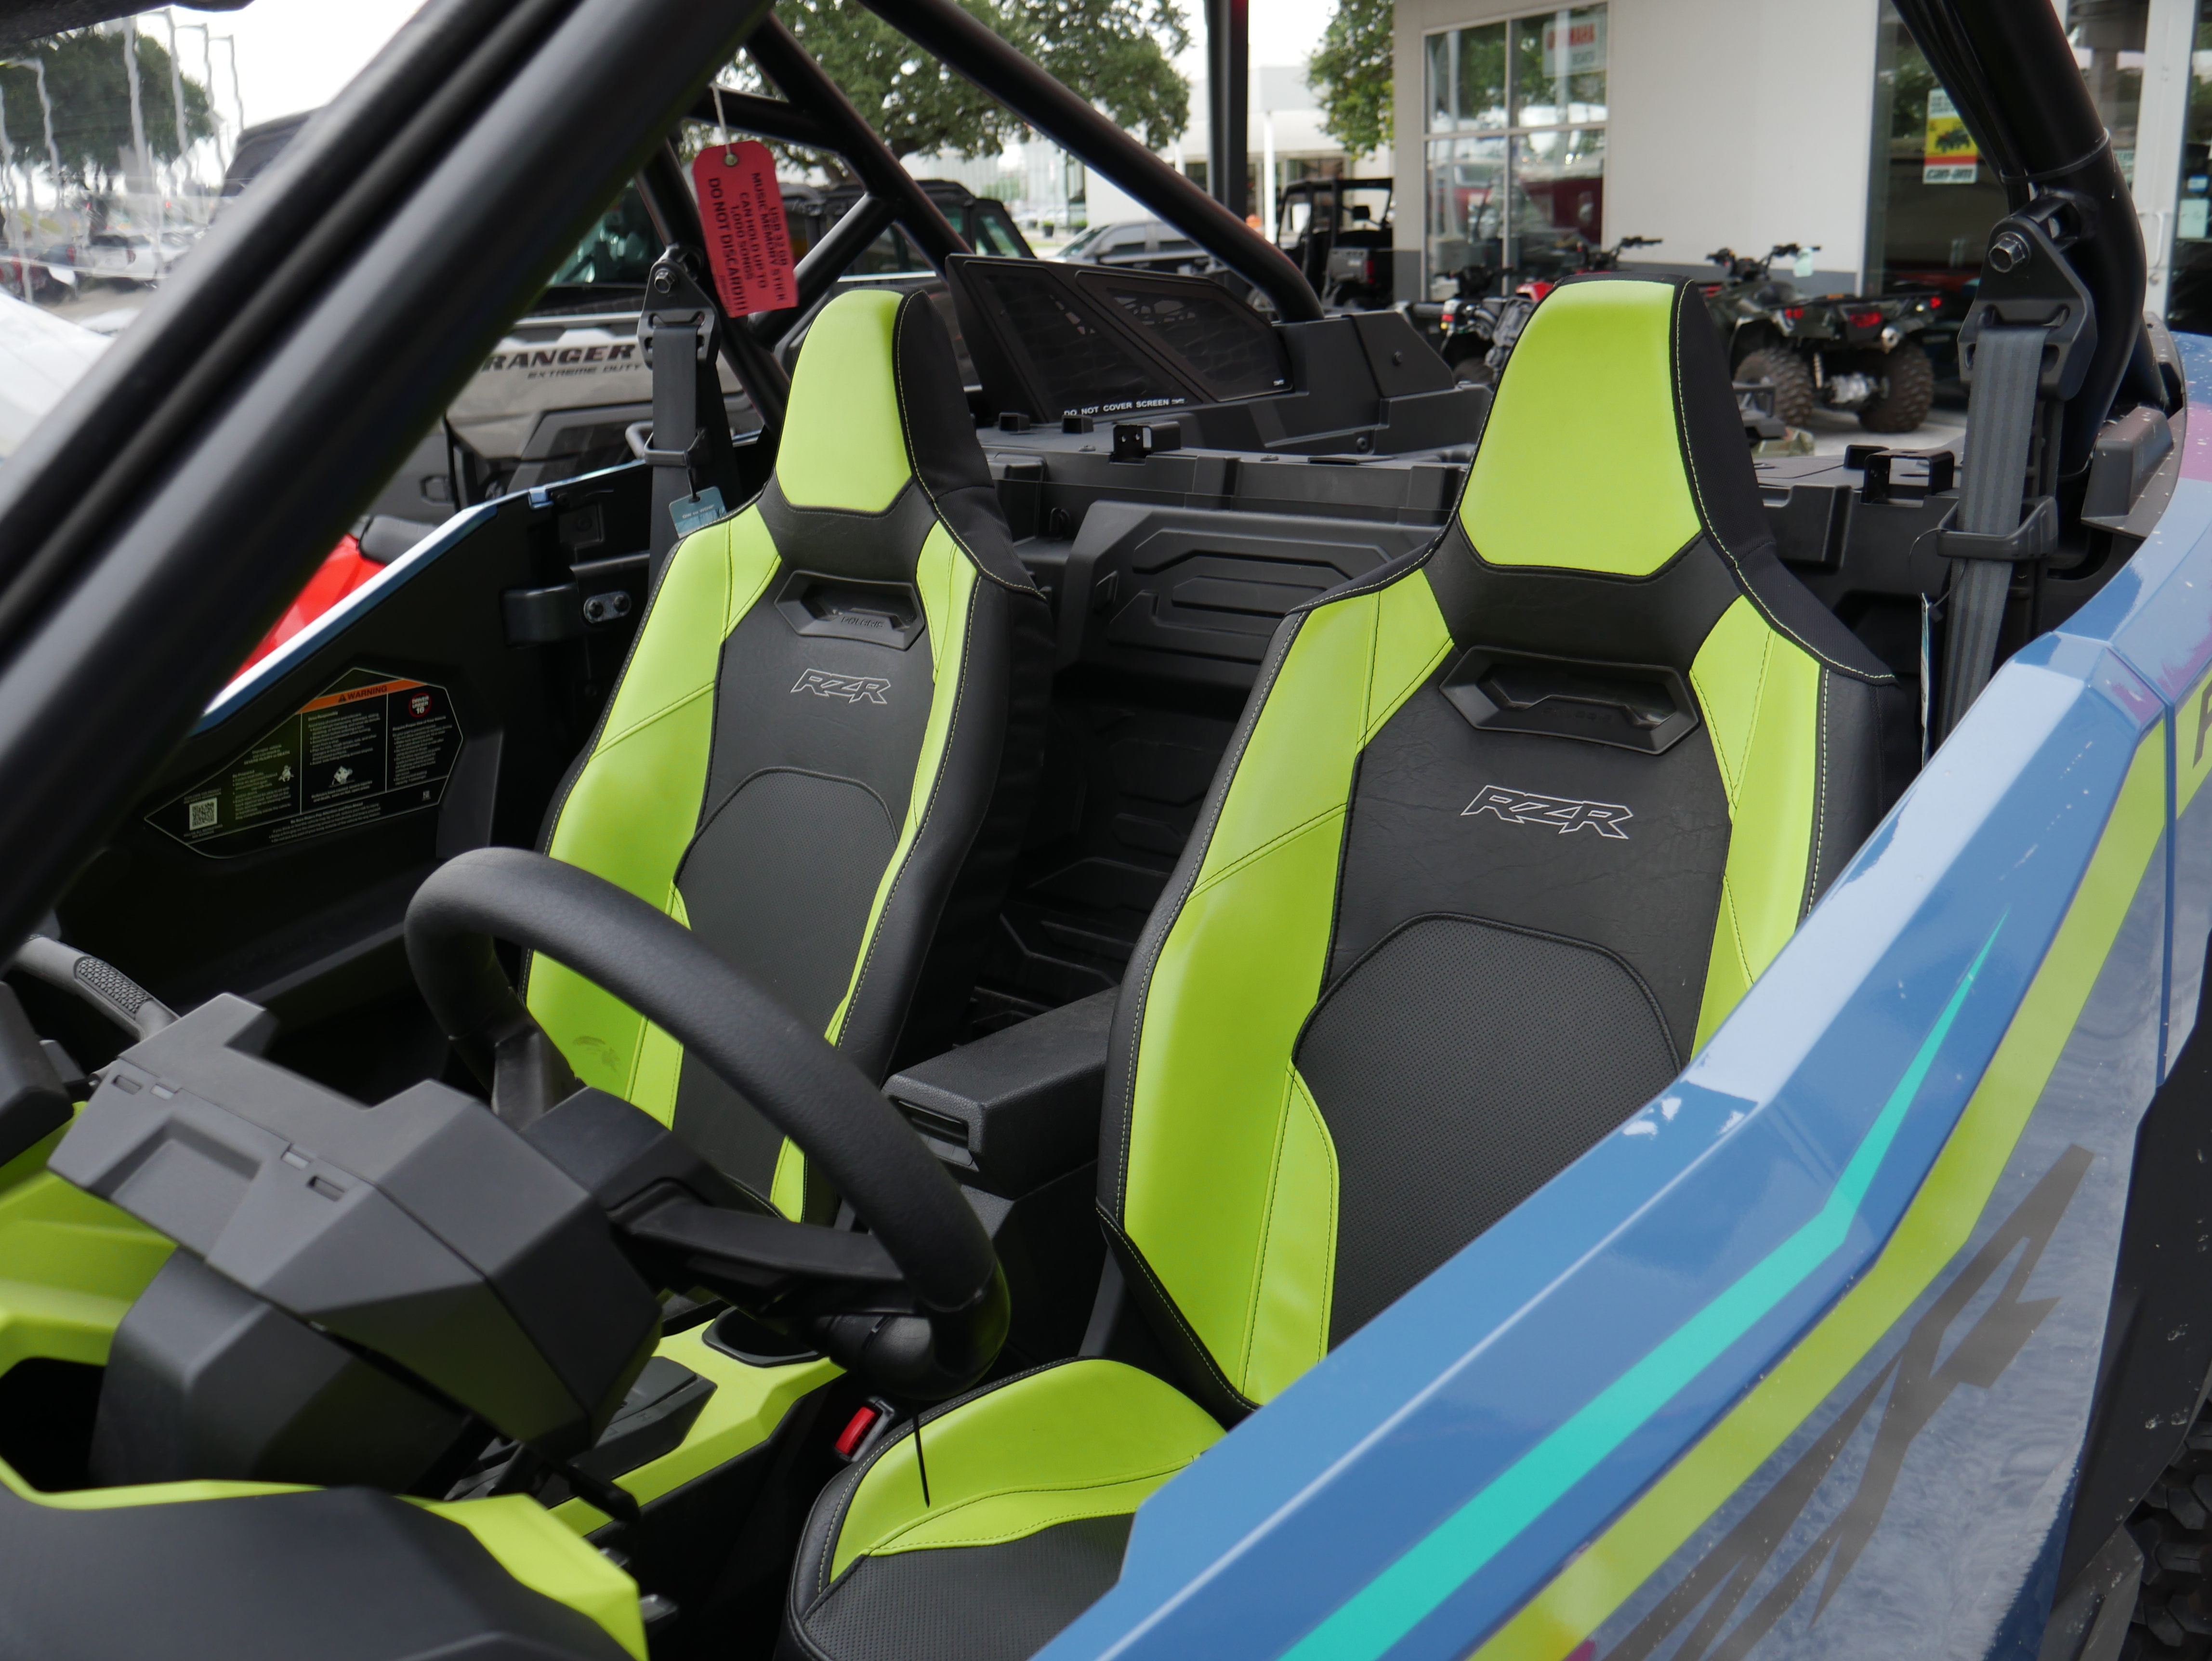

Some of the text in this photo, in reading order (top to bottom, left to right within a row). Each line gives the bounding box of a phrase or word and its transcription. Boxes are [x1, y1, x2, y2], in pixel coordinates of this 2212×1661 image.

[708, 178, 723, 199] DO
[713, 201, 729, 232] NOT
[730, 206, 754, 280] 1,000 SONGS
[740, 192, 768, 289] CAN HOLD UP TO
[752, 172, 787, 301] MUSIC MEMORY STICK
[481, 344, 635, 372] RANGER
[527, 362, 642, 379] EXTREME DUTY
[1081, 406, 1100, 415] NOT
[1103, 401, 1132, 412] COVER
[1136, 398, 1170, 408] SCREEN
[841, 616, 884, 628] POLARIS
[347, 685, 387, 700] WARNING
[790, 669, 891, 705] RZR
[1460, 784, 1633, 840] RZR
